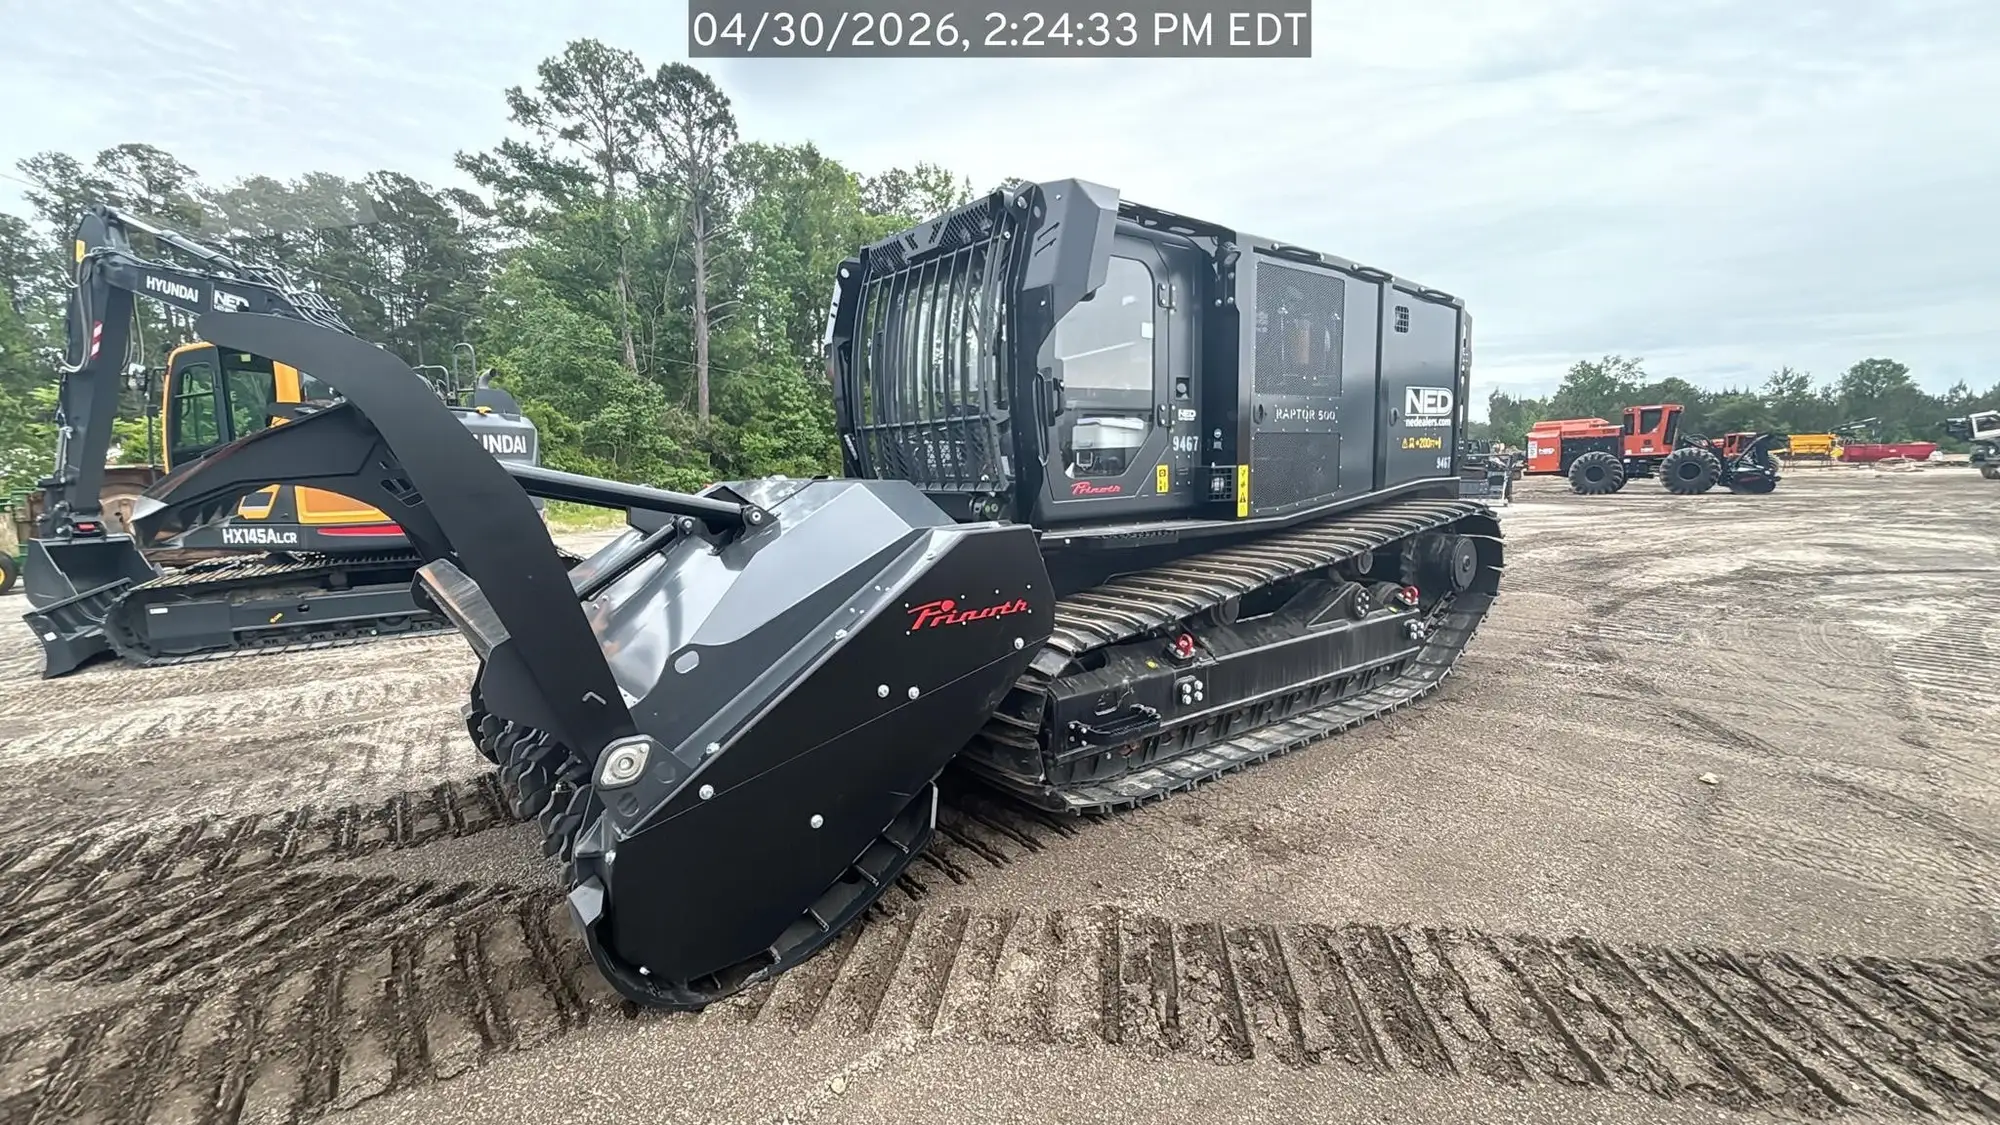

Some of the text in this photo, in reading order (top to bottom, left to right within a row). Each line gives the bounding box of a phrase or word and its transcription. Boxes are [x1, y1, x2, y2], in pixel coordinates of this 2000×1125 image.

[146, 275, 199, 303] HYUNDAI
[1405, 386, 1453, 416] NED
[1178, 409, 1196, 418] NED
[1276, 408, 1336, 421] RAPTOR 500
[1172, 435, 1199, 452] 9467
